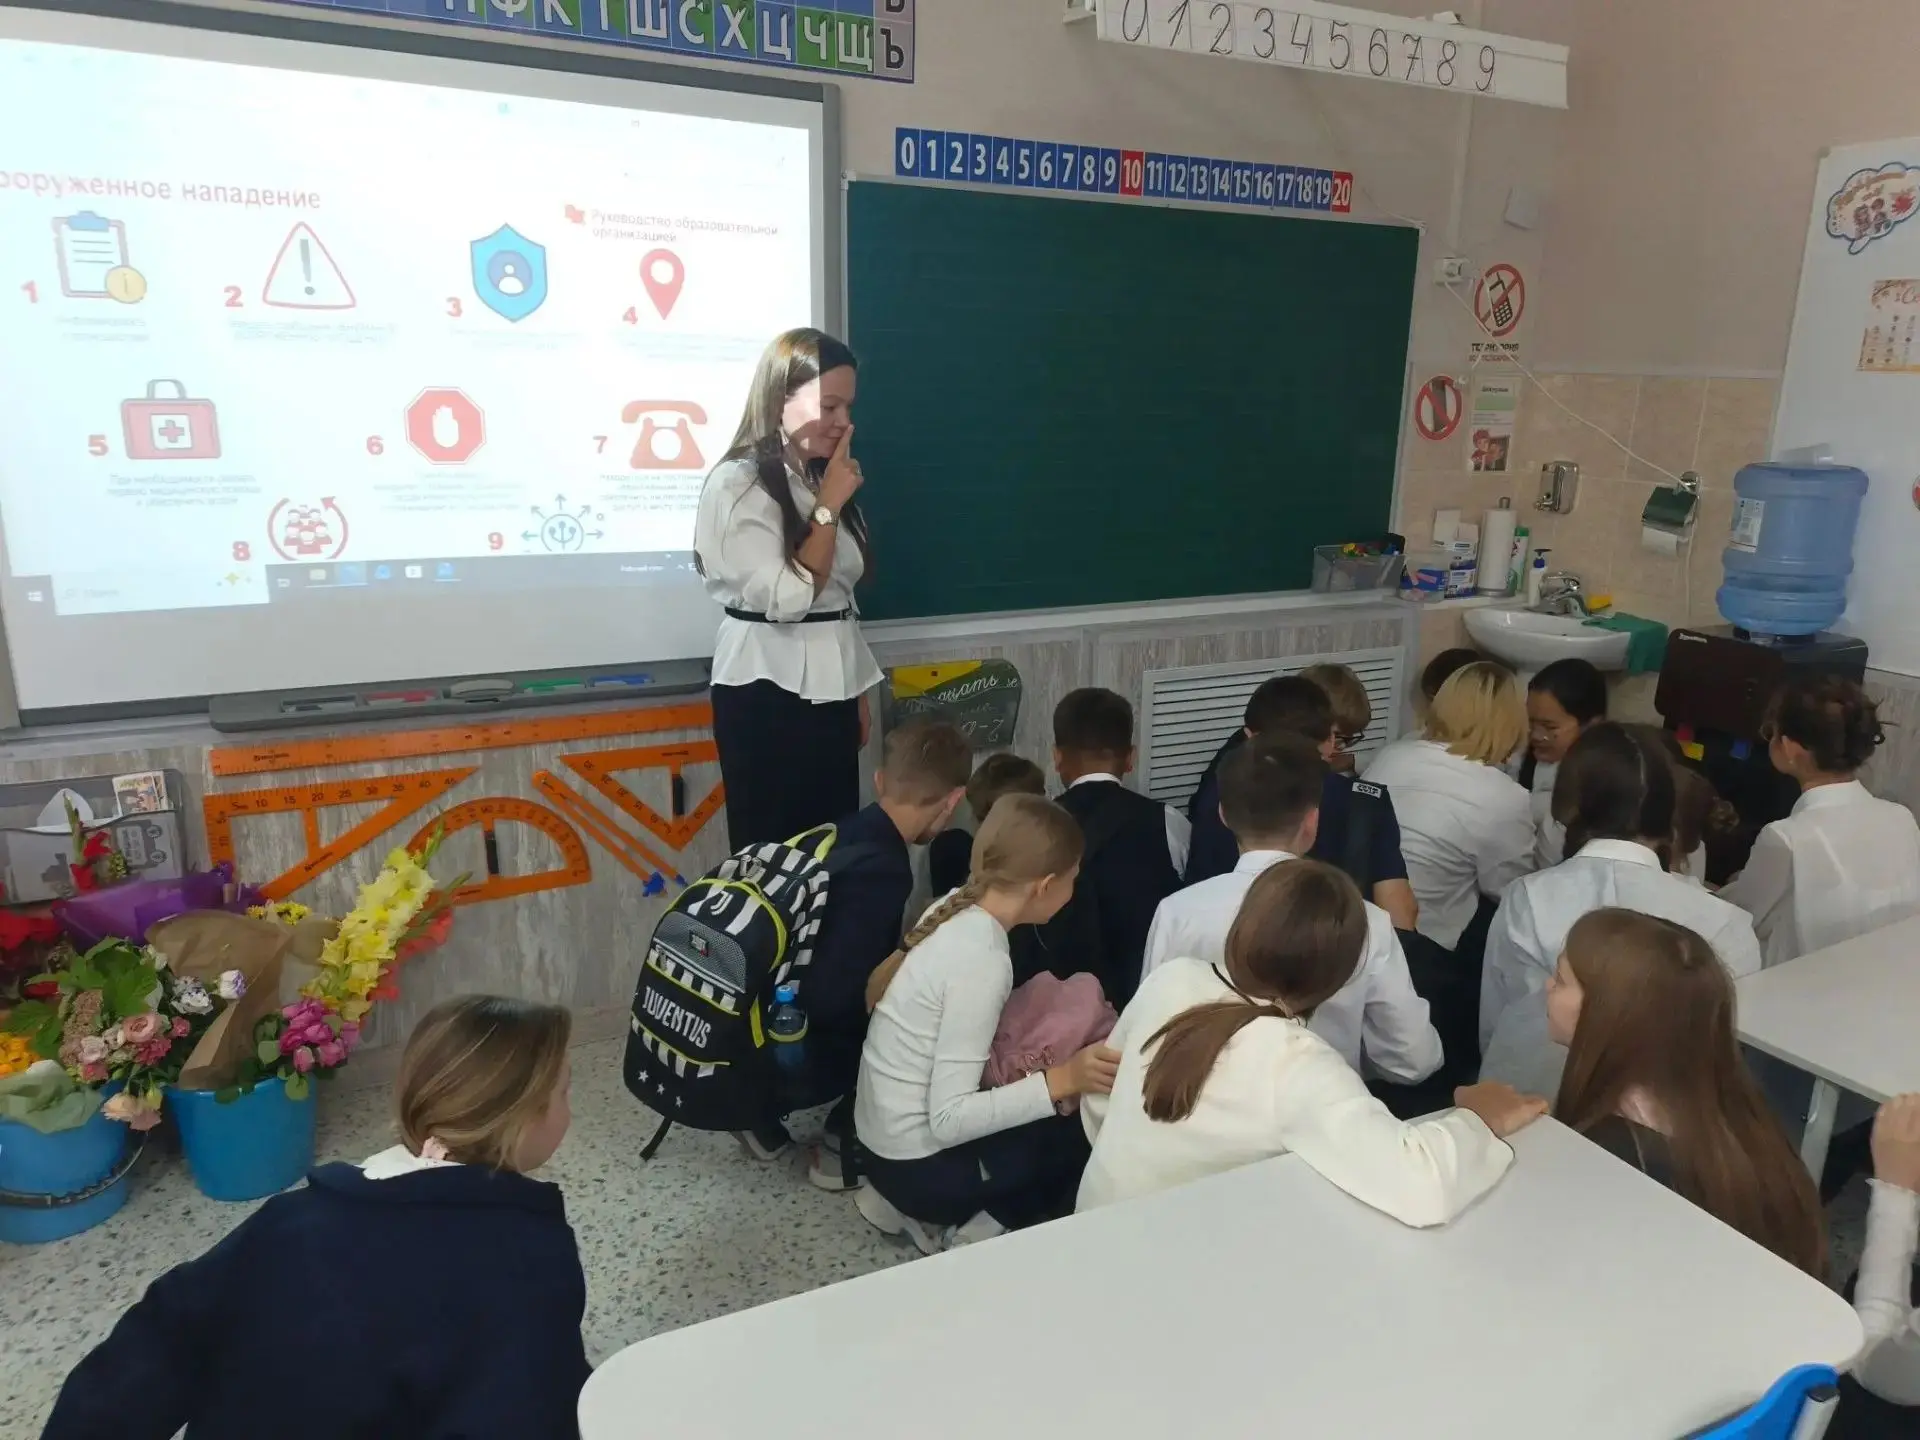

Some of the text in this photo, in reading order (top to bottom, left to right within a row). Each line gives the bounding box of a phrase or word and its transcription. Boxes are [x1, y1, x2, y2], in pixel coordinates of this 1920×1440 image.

[679, 0, 705, 44] С
[721, 4, 749, 50] Х
[763, 10, 792, 61] Ц
[803, 16, 827, 60] Ч
[838, 21, 873, 72] Щ
[880, 27, 905, 70] Ъ
[1122, 0, 1495, 91] 0 1 2 3 4 5 6 7 8 9
[901, 136, 1351, 206] 0 1 2 3 4 5 6 7 8 9 10 11 12 13 14 15 16 17 18 19 20
[182, 182, 321, 210] нападение
[590, 208, 671, 227] Руководство
[21, 281, 39, 304] 1
[223, 286, 244, 308] 2
[446, 297, 463, 318] 3
[622, 306, 639, 325] 4
[88, 434, 109, 457] 5
[366, 435, 384, 456] 6
[593, 435, 608, 454] 7
[232, 541, 251, 562] 8
[487, 532, 504, 551] 9
[642, 985, 712, 1048] JUVENTUS
